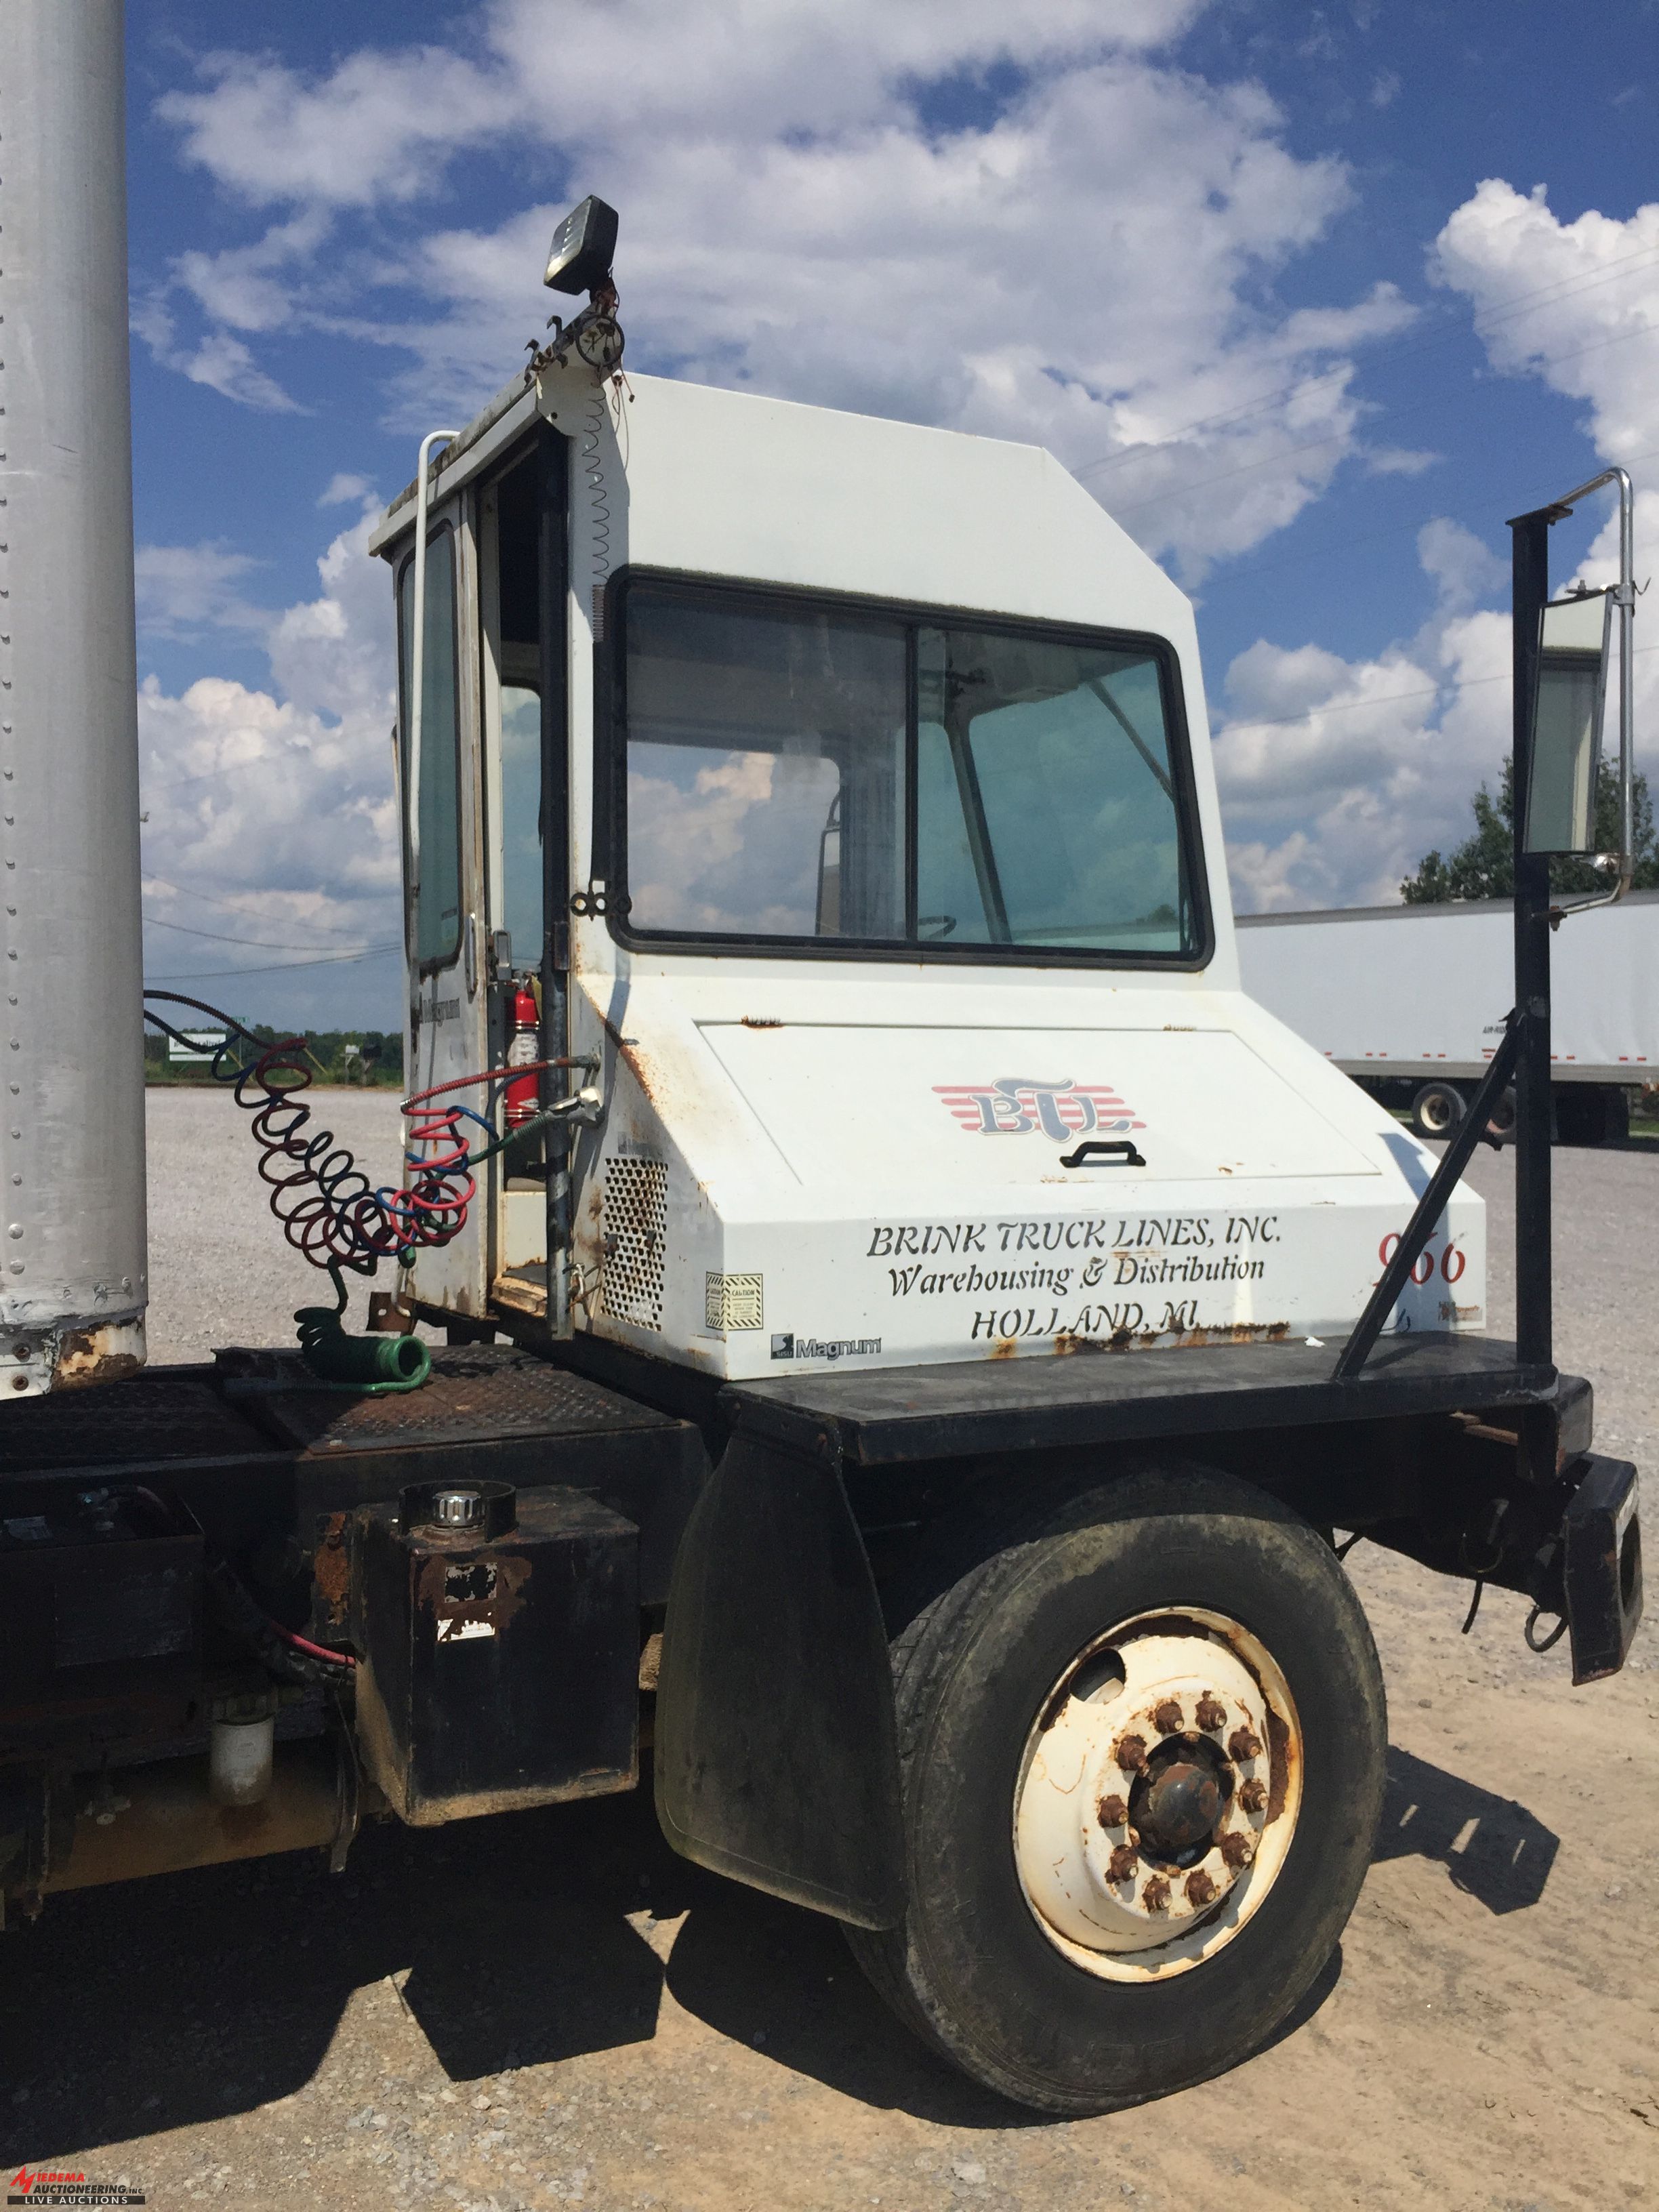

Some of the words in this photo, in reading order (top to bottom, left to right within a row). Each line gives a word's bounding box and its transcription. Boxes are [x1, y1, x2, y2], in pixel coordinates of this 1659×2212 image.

[866, 1223, 987, 1257] BRINK
[997, 1220, 1107, 1252] TRUCK
[1111, 1217, 1214, 1248] LINES,
[1225, 1216, 1281, 1244] INC.
[888, 1261, 1075, 1296] Warehousing
[1080, 1256, 1108, 1289] &
[1113, 1254, 1265, 1286] Distribution
[970, 1303, 1150, 1340] HOLLAND,
[1160, 1299, 1198, 1329] MI
[796, 1338, 882, 1361] Magnum
